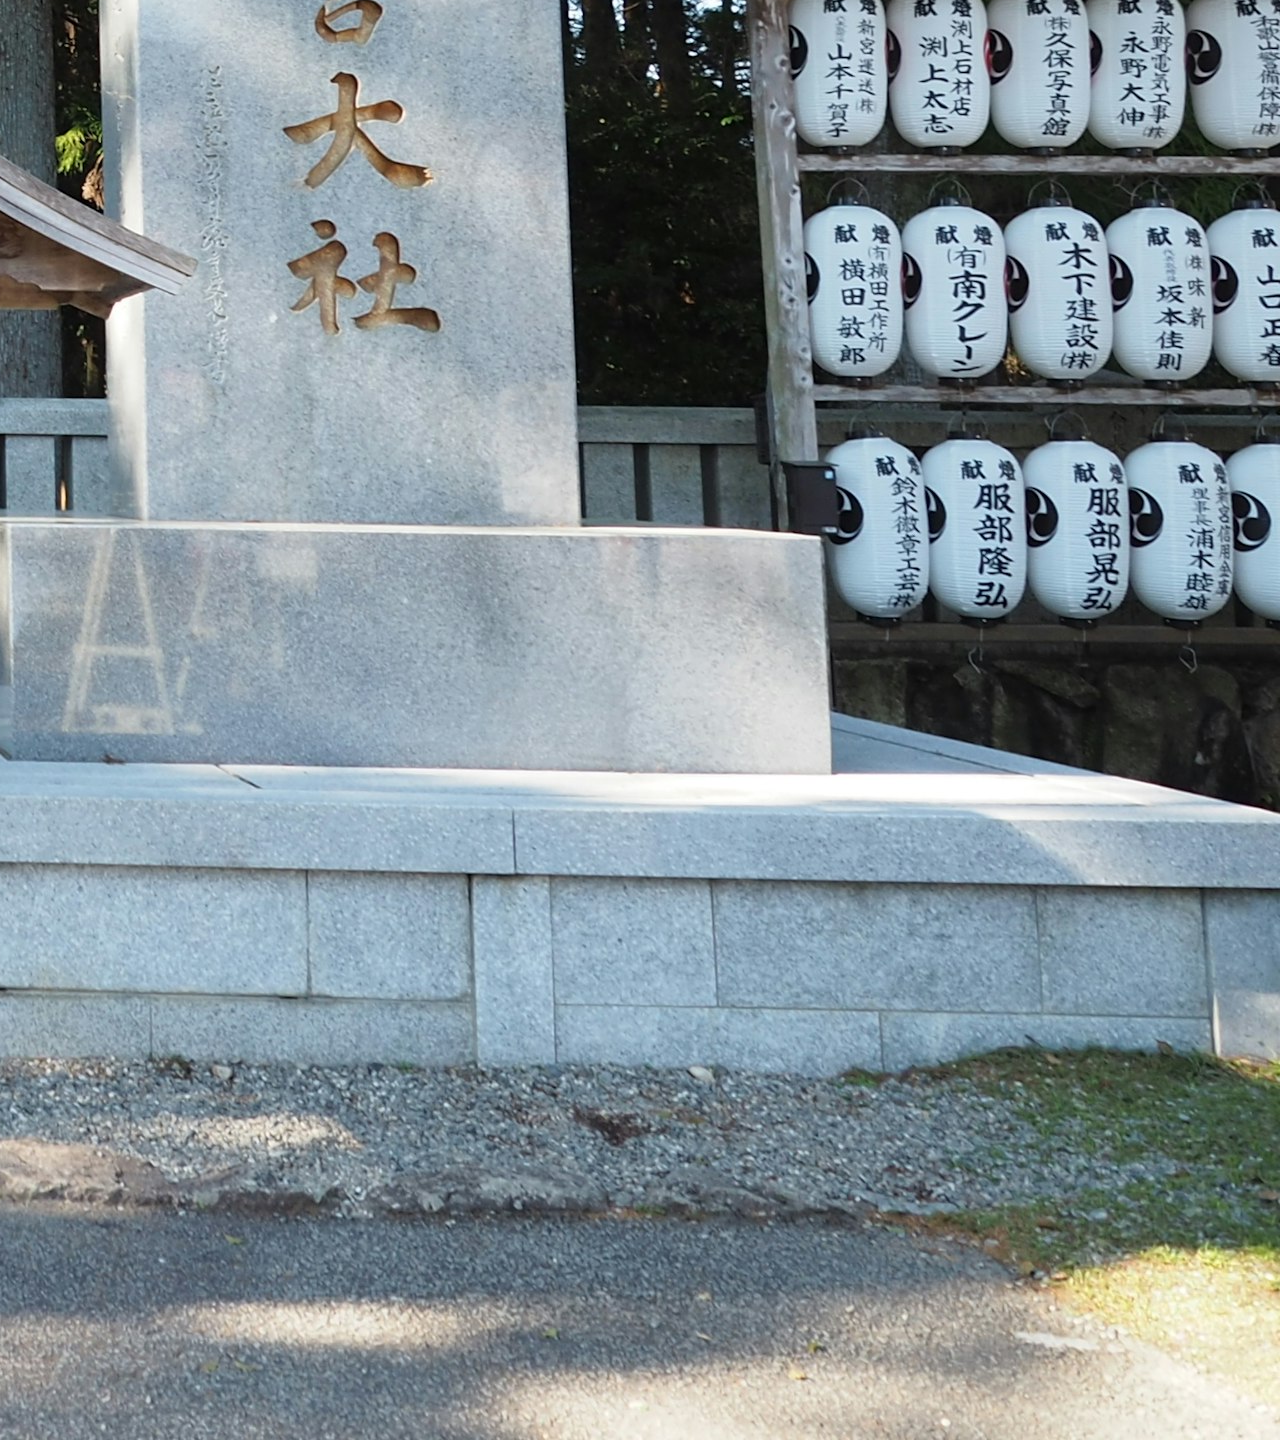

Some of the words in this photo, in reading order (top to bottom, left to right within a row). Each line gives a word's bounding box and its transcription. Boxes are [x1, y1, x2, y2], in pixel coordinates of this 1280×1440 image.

[825, 43, 855, 138] 山本千賀子
[1117, 31, 1149, 127] 永野大伸
[837, 258, 866, 365] 横田敏郎
[1155, 284, 1187, 371] 坂本佳則
[973, 484, 1015, 609] 服部隆弘
[1080, 487, 1122, 611] 服部晃弘
